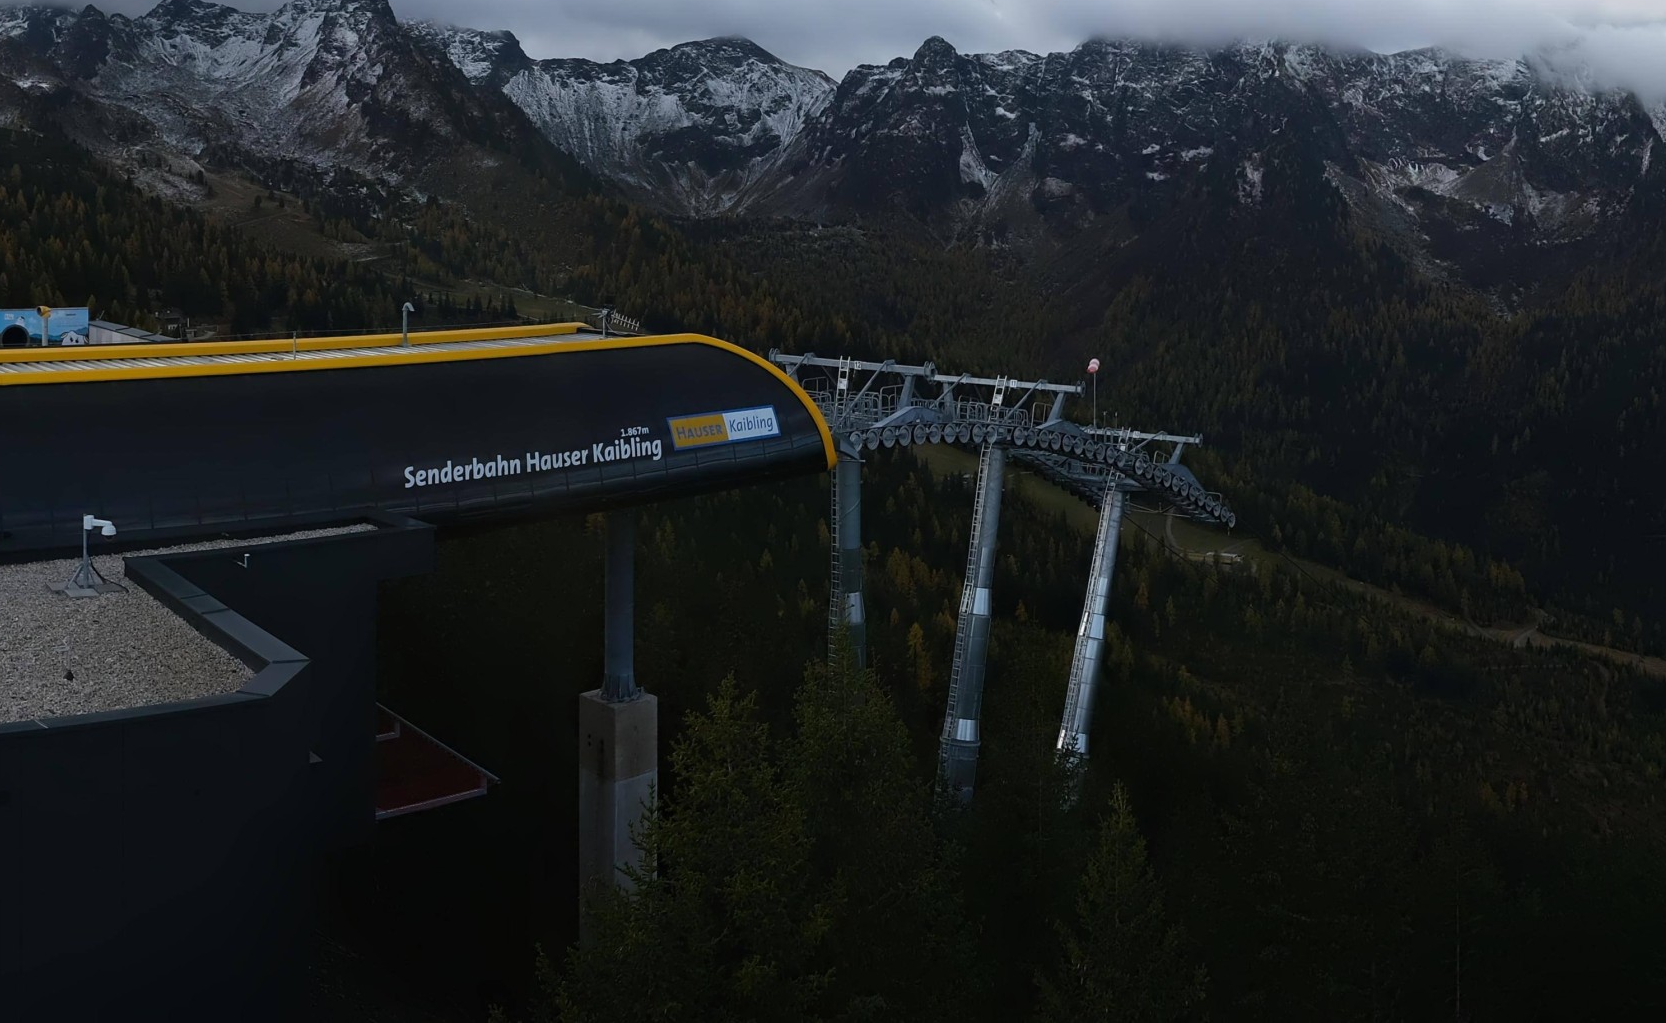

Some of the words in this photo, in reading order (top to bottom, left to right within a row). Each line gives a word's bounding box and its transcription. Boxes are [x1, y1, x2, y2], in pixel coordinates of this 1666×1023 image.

[620, 426, 650, 437] 1.867m
[676, 423, 723, 441] HAUSER
[728, 415, 774, 434] Kaibling
[403, 455, 521, 489] Senderbahn
[525, 447, 589, 473] Hauser
[592, 436, 662, 463] Kaibling
